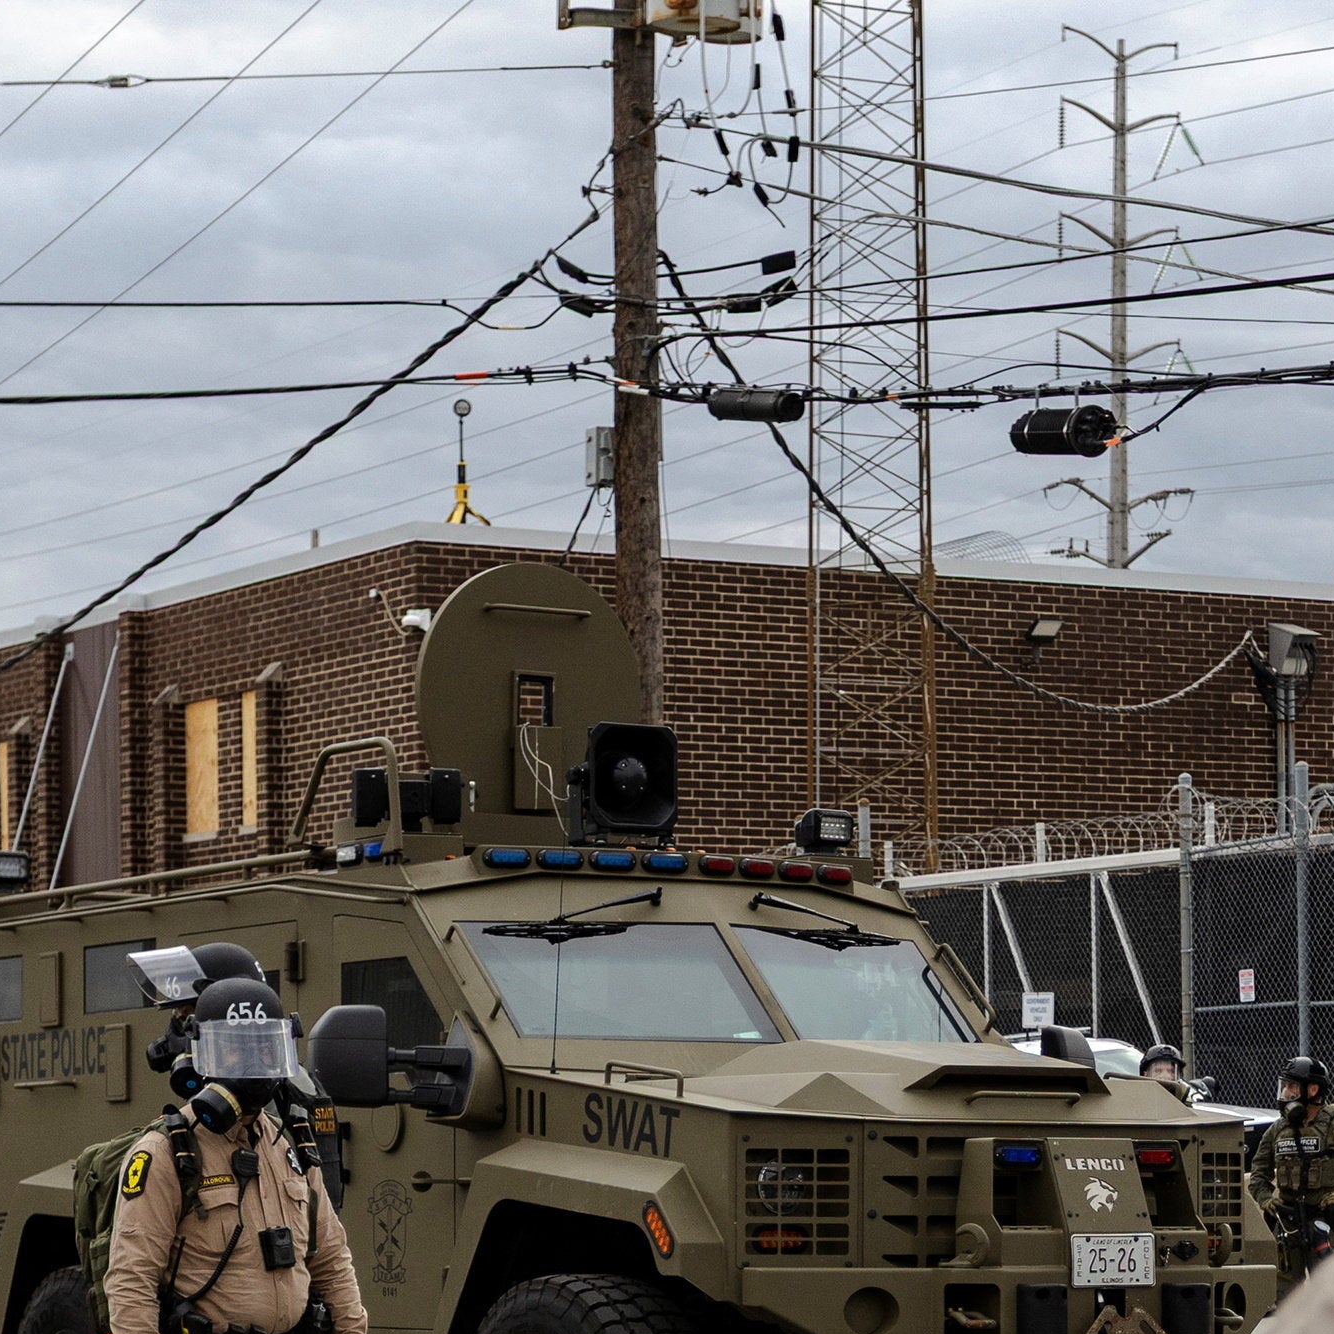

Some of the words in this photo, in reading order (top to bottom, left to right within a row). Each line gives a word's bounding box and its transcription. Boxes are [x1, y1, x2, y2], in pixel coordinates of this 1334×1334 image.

[227, 1002, 267, 1026] 656
[1, 1033, 46, 1081] STATE
[51, 1026, 105, 1077] POLICE
[583, 1092, 680, 1158] SWAT
[1065, 1158, 1125, 1171] LENCO
[1089, 1247, 1136, 1273] 25-26
[379, 1271, 400, 1280] TEAM
[382, 1287, 398, 1297] 6141
